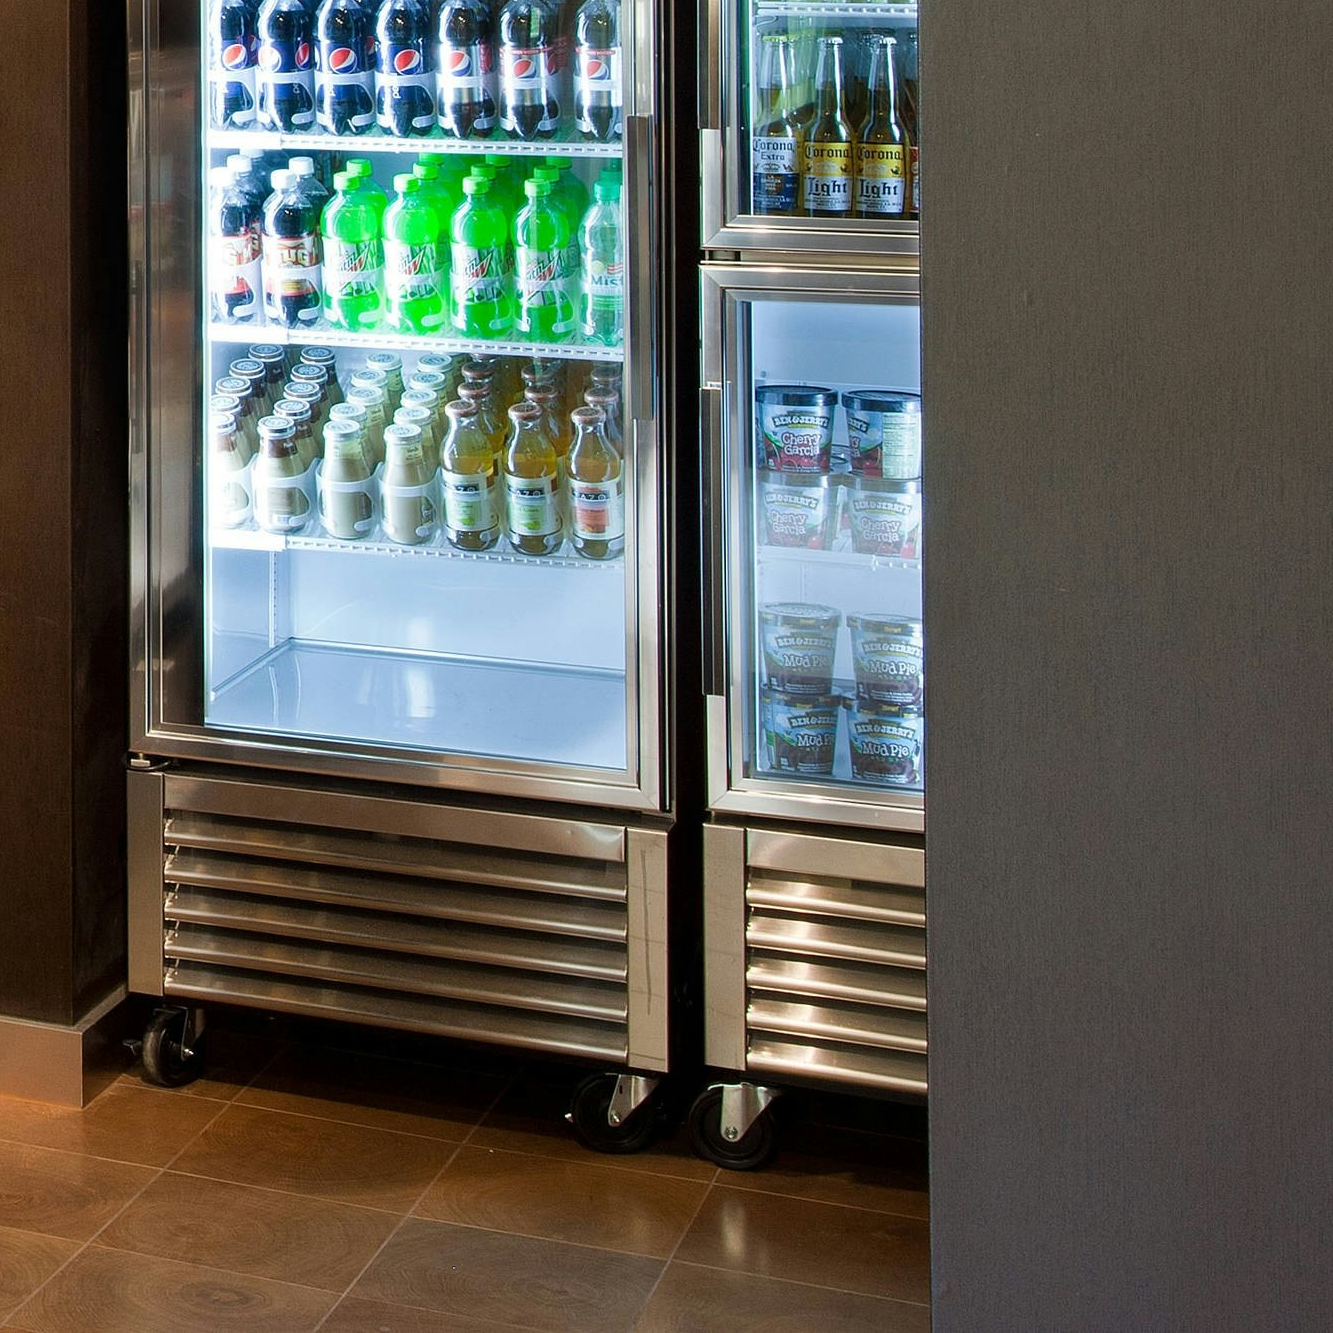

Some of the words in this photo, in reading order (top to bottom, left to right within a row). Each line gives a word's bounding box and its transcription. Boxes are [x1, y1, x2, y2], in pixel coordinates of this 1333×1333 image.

[754, 139, 794, 153] Corona
[804, 146, 851, 159] Corona
[761, 153, 785, 161] Extra
[857, 147, 902, 161] Corona
[808, 177, 847, 198] Light
[860, 179, 898, 199] Light
[782, 433, 821, 445] Cherry
[784, 445, 820, 456] Garcia
[861, 518, 901, 533] Cherry
[863, 530, 900, 542] Garcia
[783, 655, 811, 667] Mud
[869, 661, 899, 674] Mud
[899, 662, 917, 676] Pie
[856, 723, 873, 734] BEN
[798, 734, 823, 747] Mud
[862, 741, 888, 756] Mud
[889, 743, 909, 758] Pie
